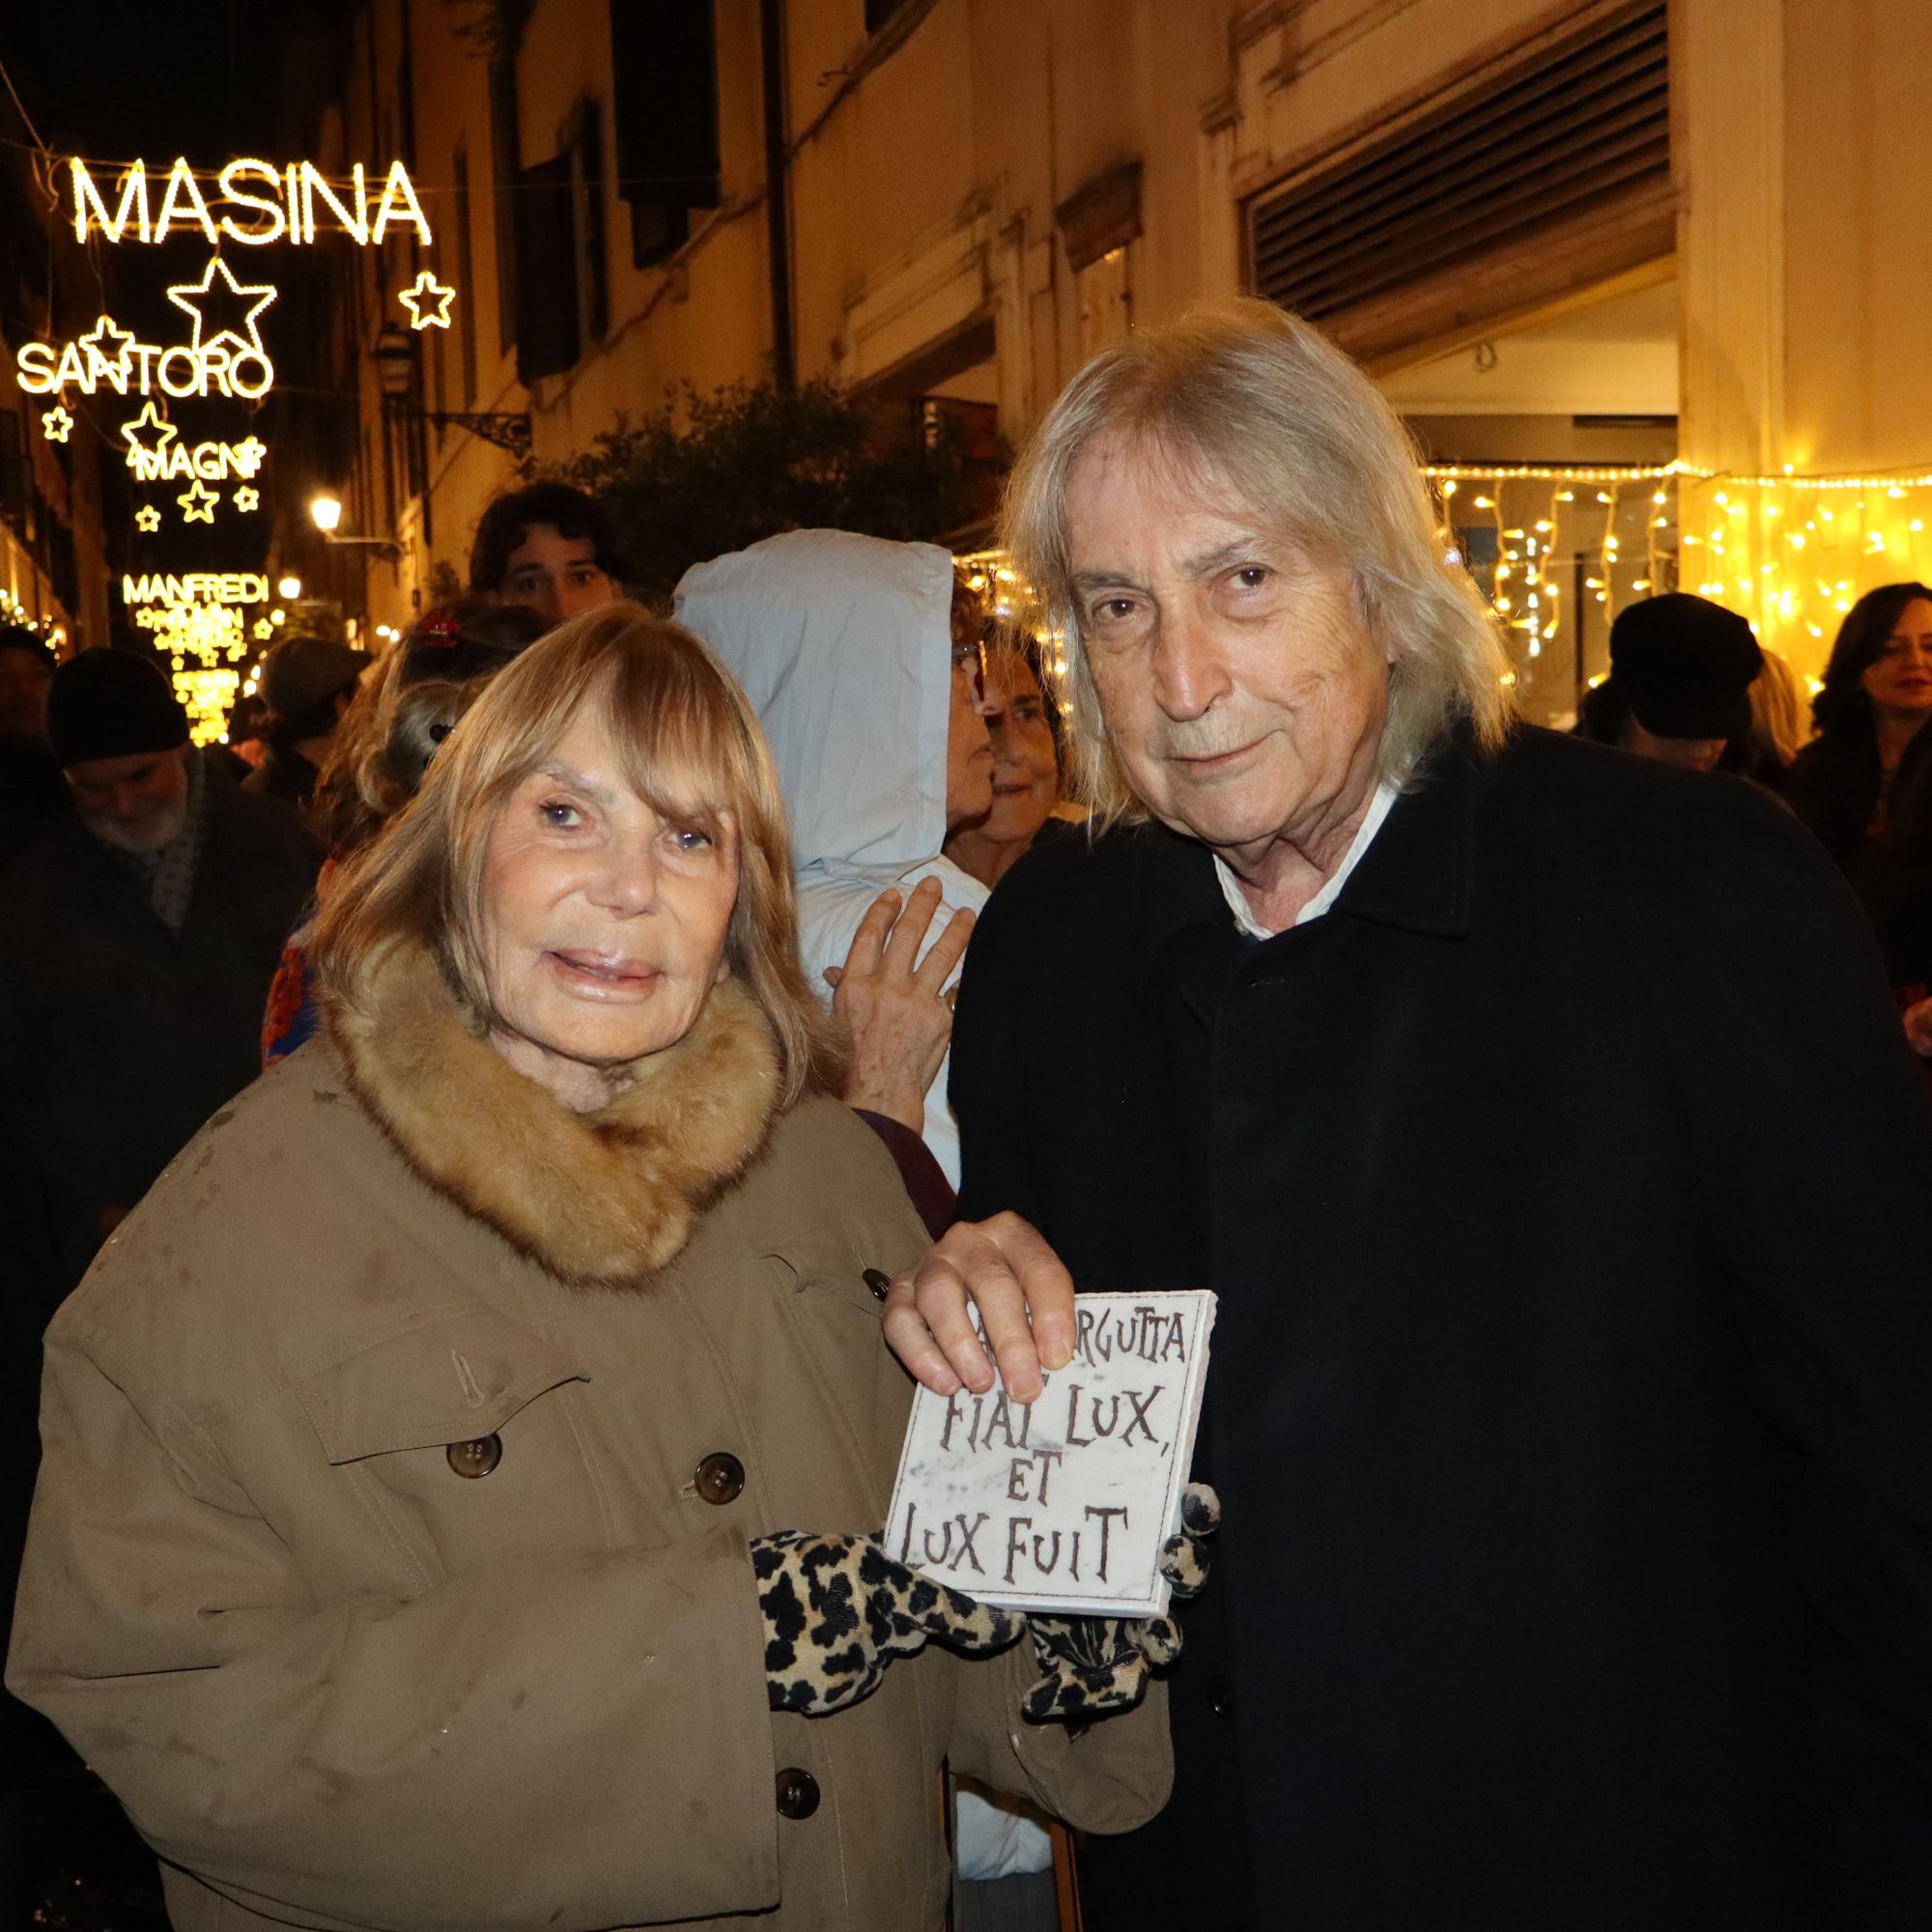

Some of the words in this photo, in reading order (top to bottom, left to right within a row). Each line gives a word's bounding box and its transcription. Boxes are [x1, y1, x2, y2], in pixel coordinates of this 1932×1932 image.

[71, 156, 432, 246] MASINA
[16, 342, 274, 399] SANTORO
[123, 573, 270, 605] MANFREDI
[1071, 1305, 1186, 1368] RGUTTA
[1007, 1449, 1063, 1507] ET
[900, 1502, 990, 1576] LUX
[1003, 1504, 1129, 1585] FUIT
